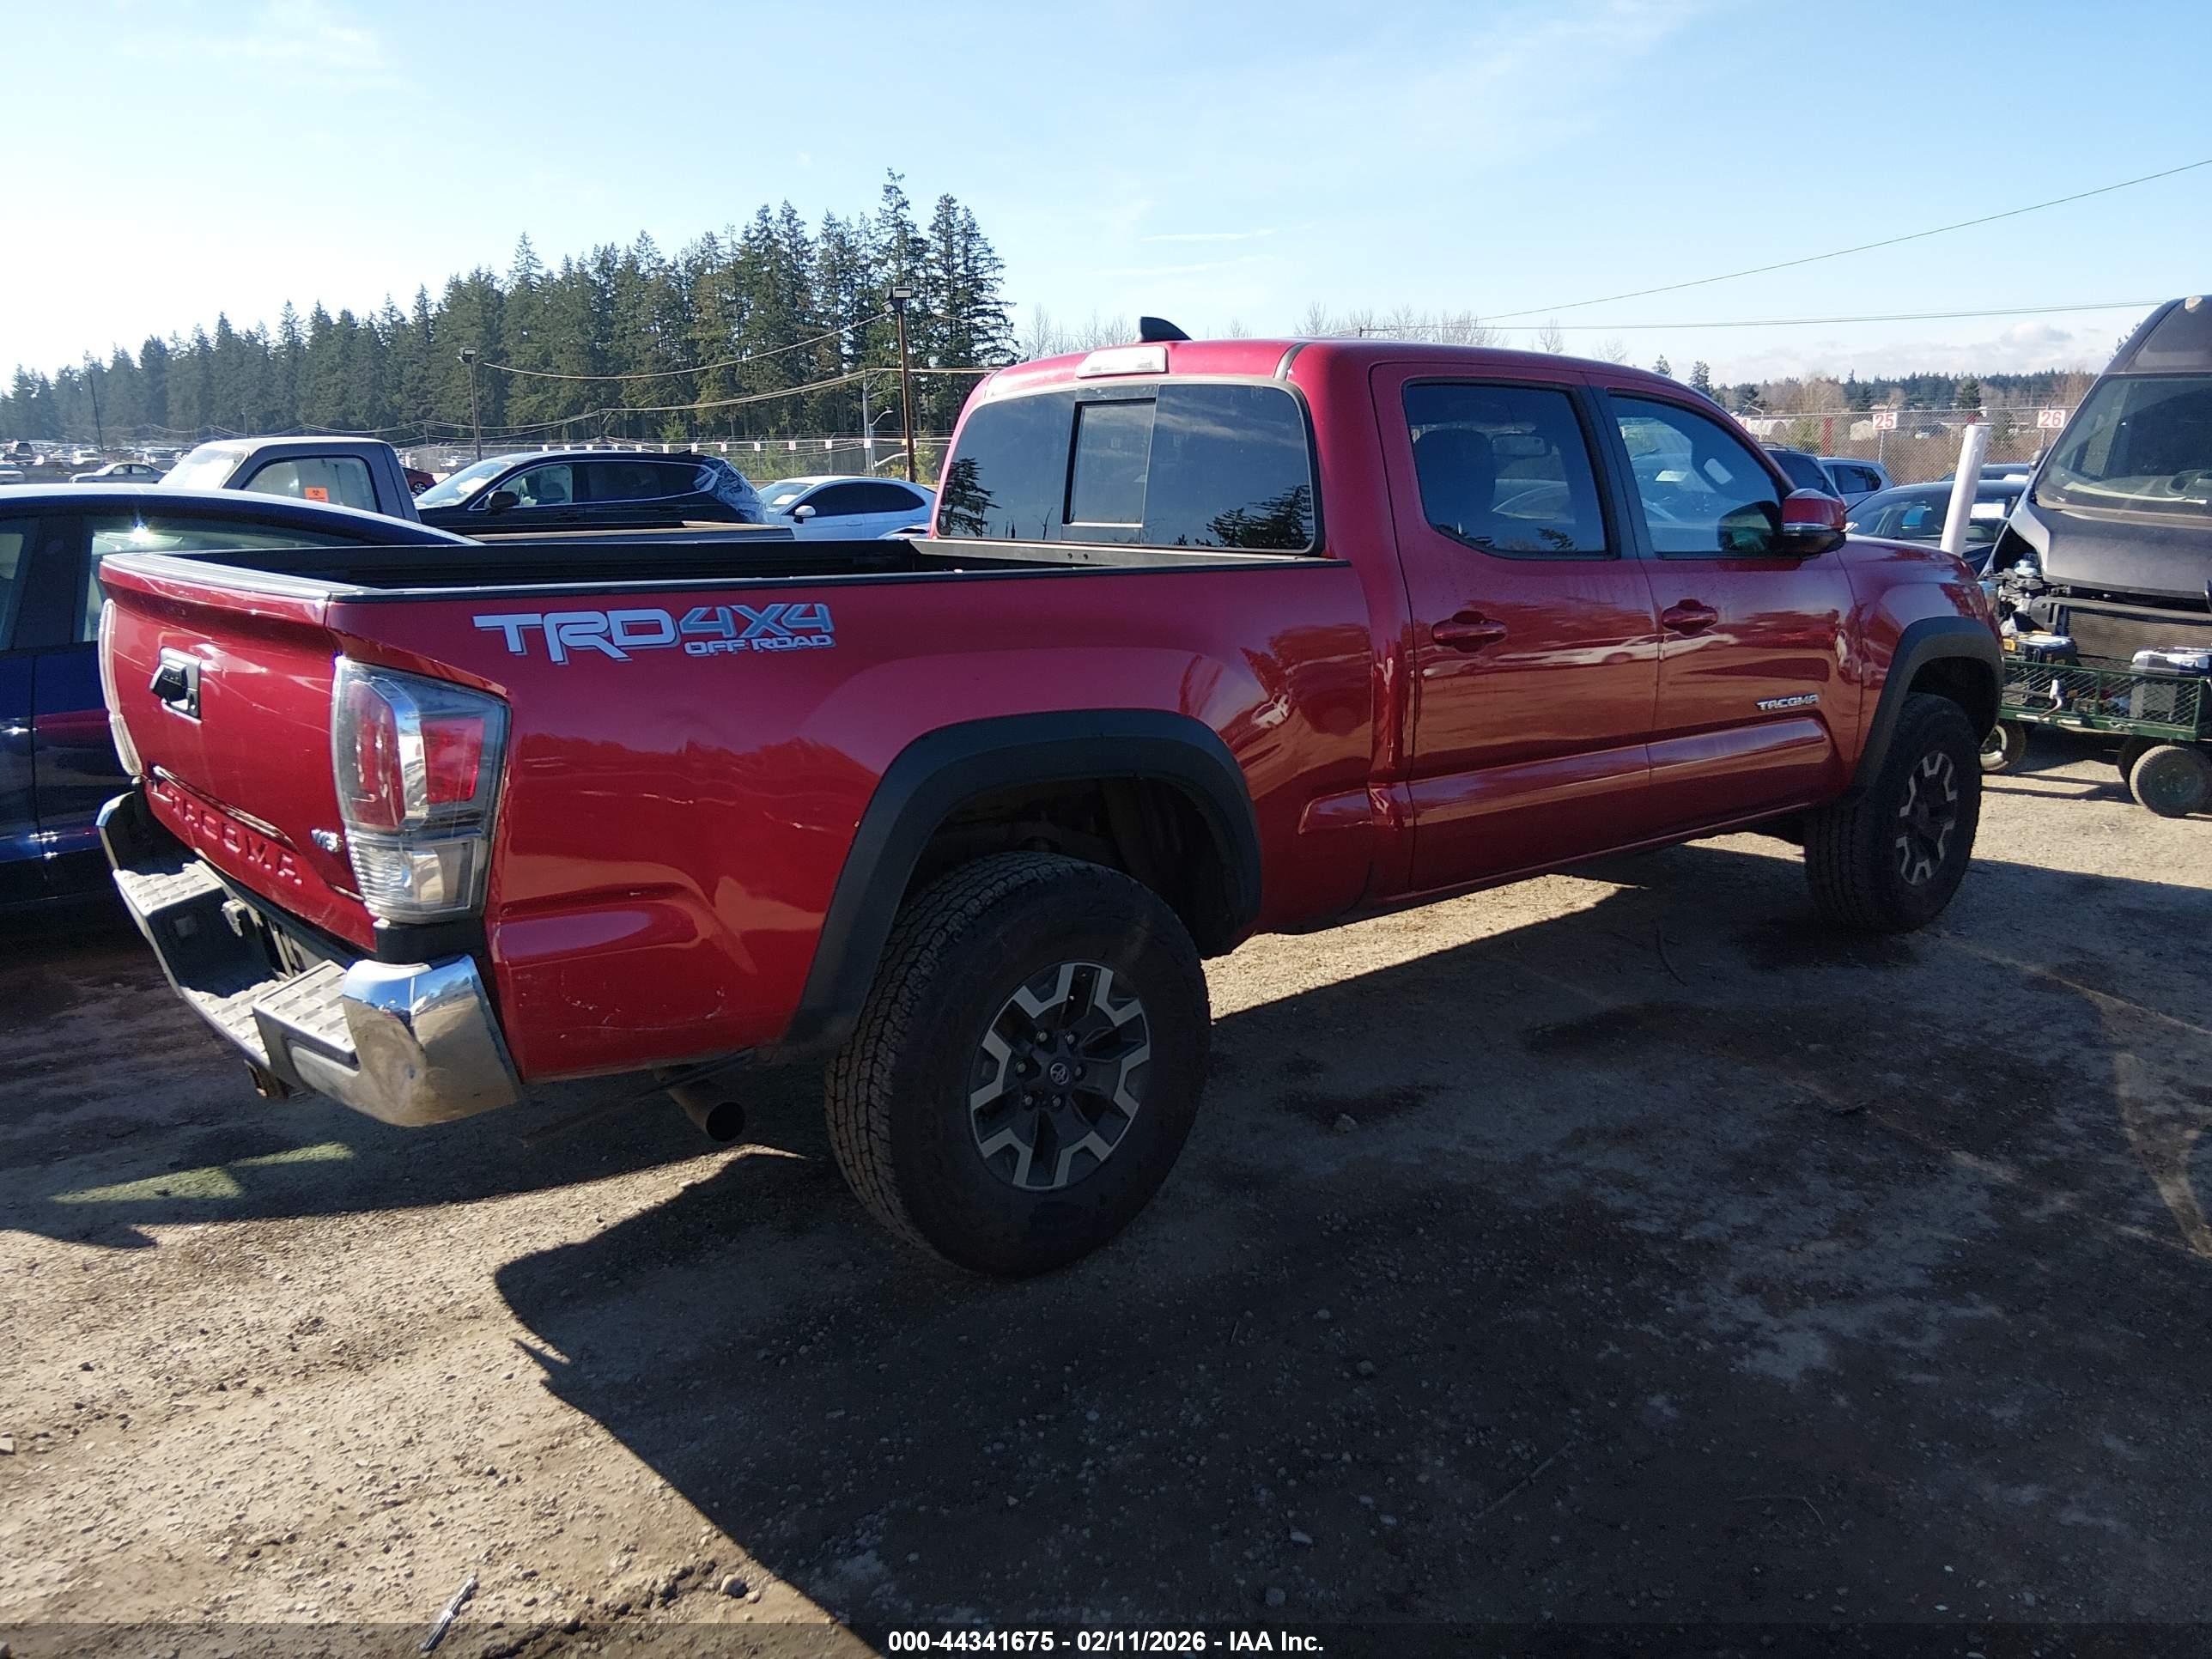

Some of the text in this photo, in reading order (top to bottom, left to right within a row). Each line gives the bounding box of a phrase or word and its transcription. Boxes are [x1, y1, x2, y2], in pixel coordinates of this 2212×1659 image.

[1875, 413, 1895, 429] 25
[2039, 411, 2062, 428] 26
[472, 608, 681, 665] TRD
[684, 633, 836, 657] OFF ROAD
[1756, 694, 1820, 711] TACOMA
[165, 786, 304, 885] TACOMA
